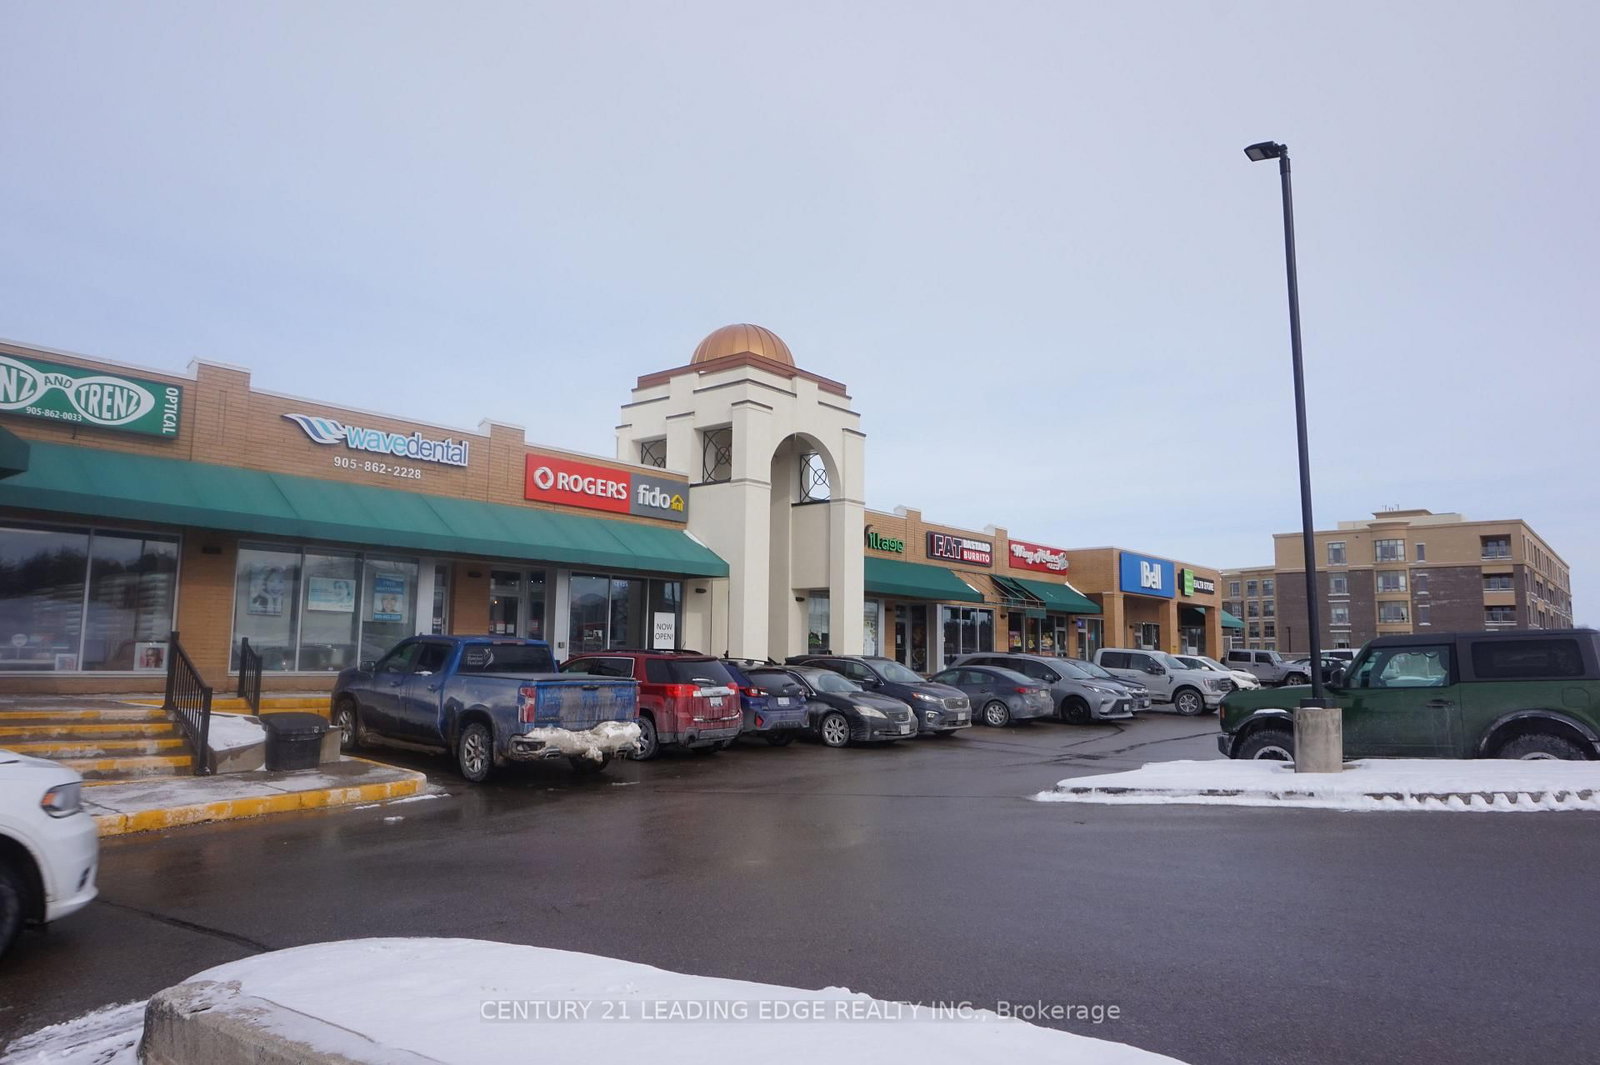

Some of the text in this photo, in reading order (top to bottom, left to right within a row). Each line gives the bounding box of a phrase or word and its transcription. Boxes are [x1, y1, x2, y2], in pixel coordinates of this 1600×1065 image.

[44, 375, 73, 389] AND
[79, 384, 139, 420] TRENZ
[26, 406, 82, 422] 905-862-0033
[162, 387, 179, 434] OPTICAL
[346, 426, 469, 466] wavedental
[334, 457, 421, 479] 905-862-2228
[557, 472, 628, 500] ROGERS
[637, 484, 671, 509] fido
[935, 535, 962, 559] FAT
[963, 550, 990, 563] BURRITO
[656, 623, 673, 631] NOW
